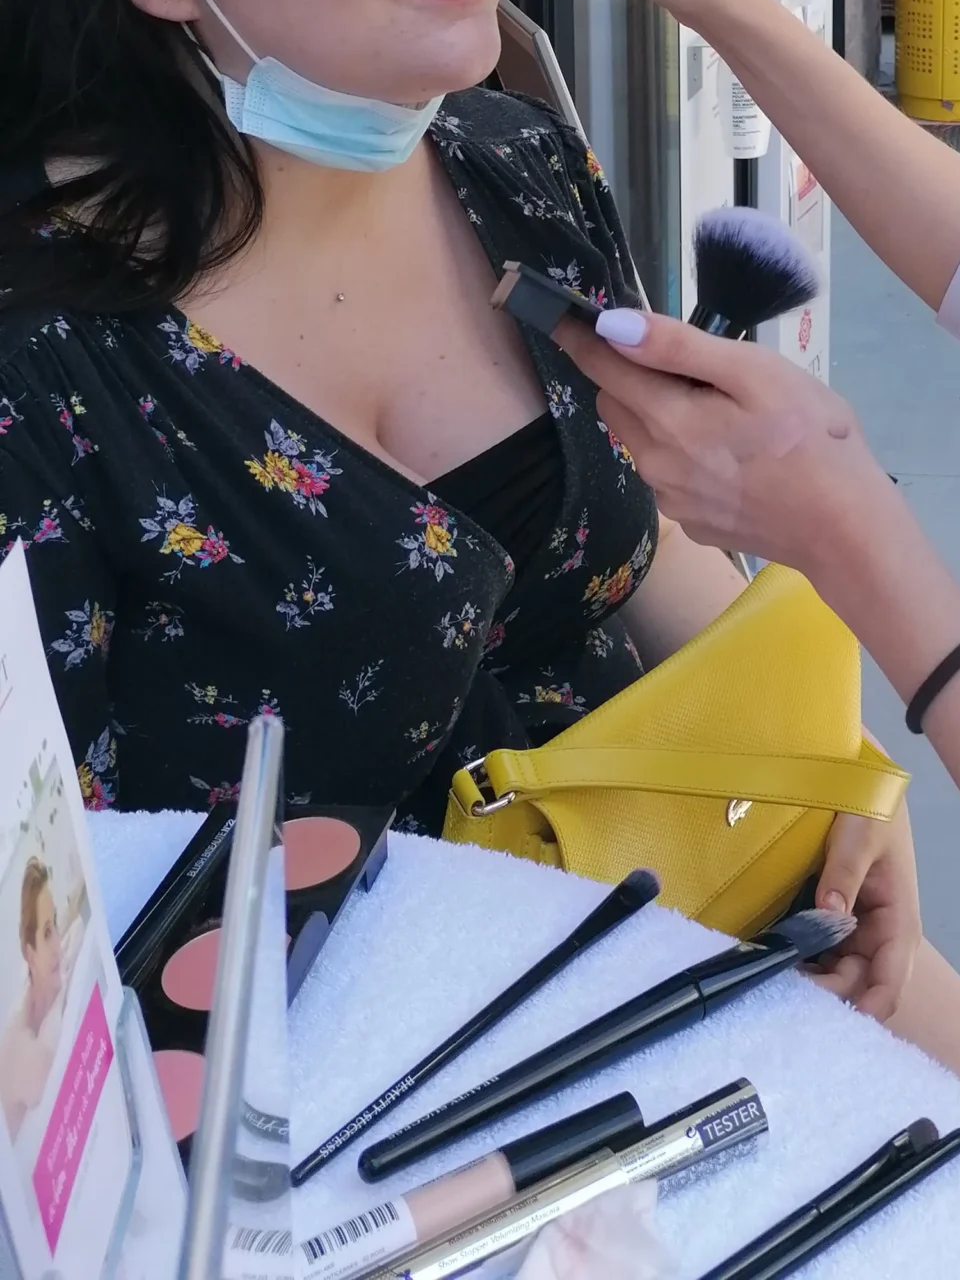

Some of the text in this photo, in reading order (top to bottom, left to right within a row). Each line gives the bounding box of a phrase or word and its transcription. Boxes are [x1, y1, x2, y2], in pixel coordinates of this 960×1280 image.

[371, 1075, 415, 1115] BEAUTY
[319, 1109, 373, 1158] SUCCESS
[702, 1101, 760, 1141] TESTER
[438, 1205, 561, 1271] Show Stopper Volumizing Mascara
